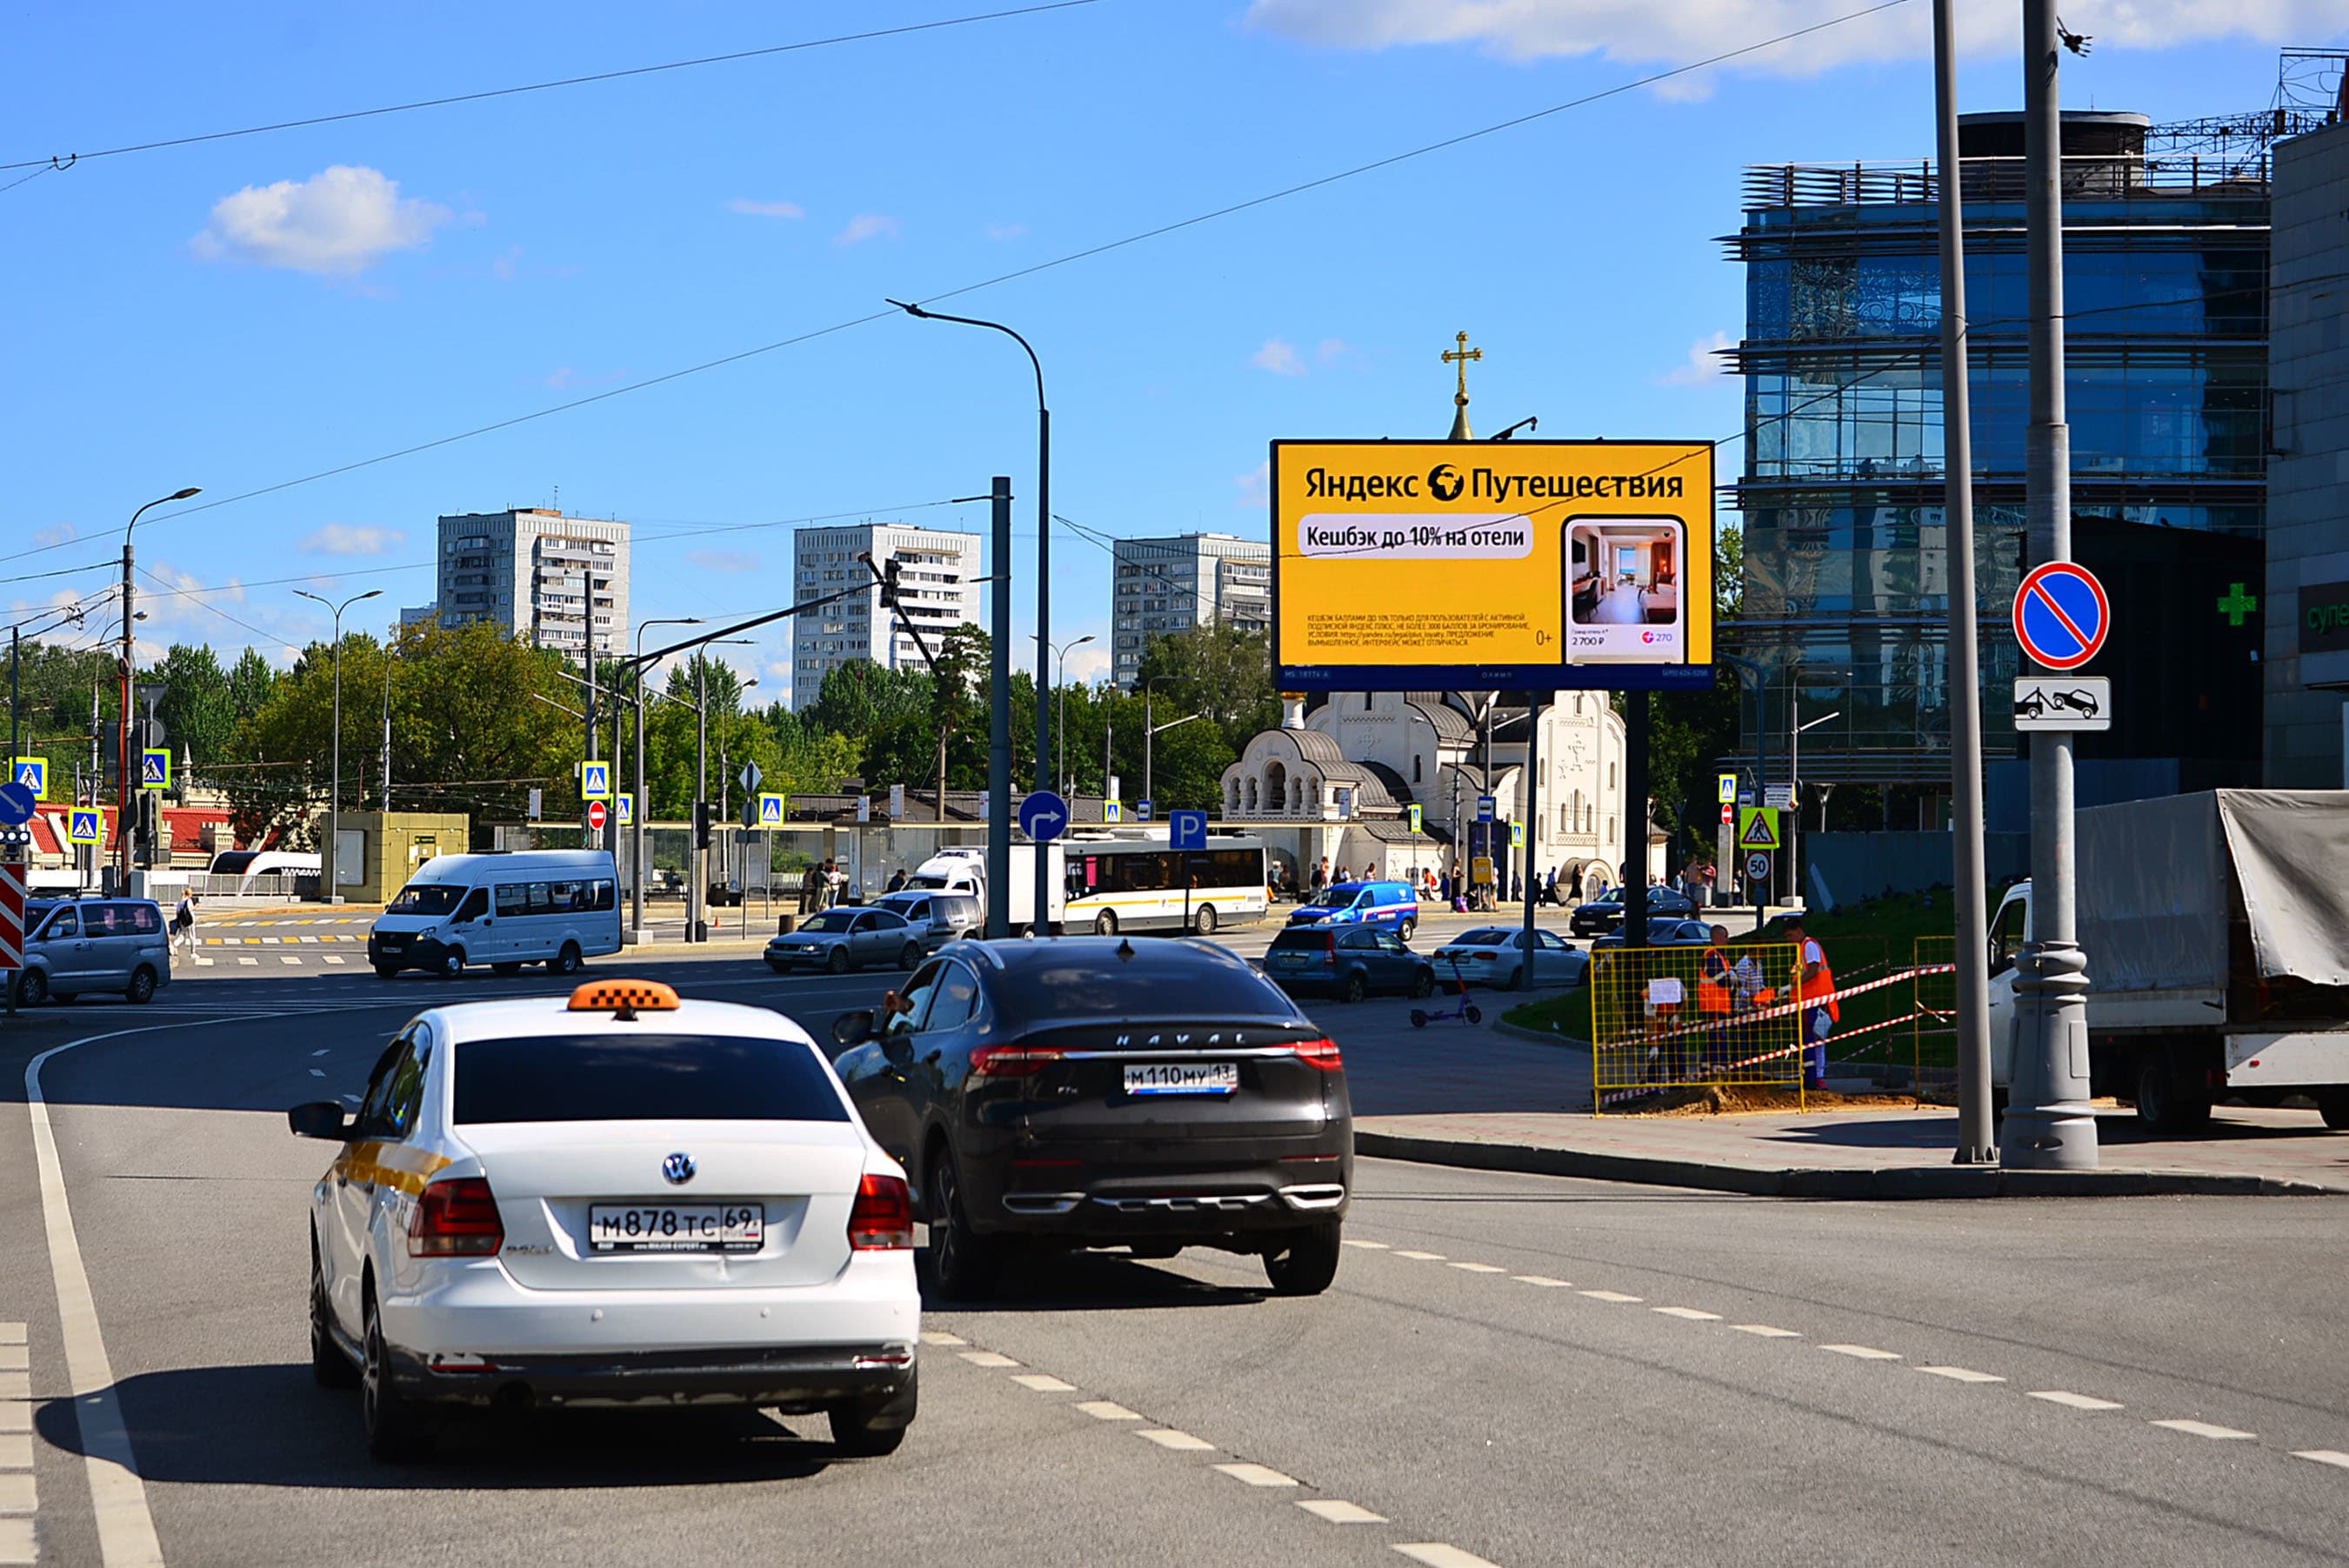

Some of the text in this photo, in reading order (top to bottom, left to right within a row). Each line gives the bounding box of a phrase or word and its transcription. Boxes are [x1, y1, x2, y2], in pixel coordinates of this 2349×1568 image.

[1305, 467, 1684, 503] Яндекс Путешествия
[1307, 525, 1525, 549] Кешбэк до 10% на отели
[1536, 630, 1553, 645] 0+
[1656, 633, 1672, 642] 270
[1180, 815, 1199, 844] P
[1750, 859, 1766, 872] 50
[1116, 1032, 1245, 1045] HAVAL
[1131, 1064, 1231, 1085] М110МУ 13
[603, 1208, 752, 1238] М878ТС 69
